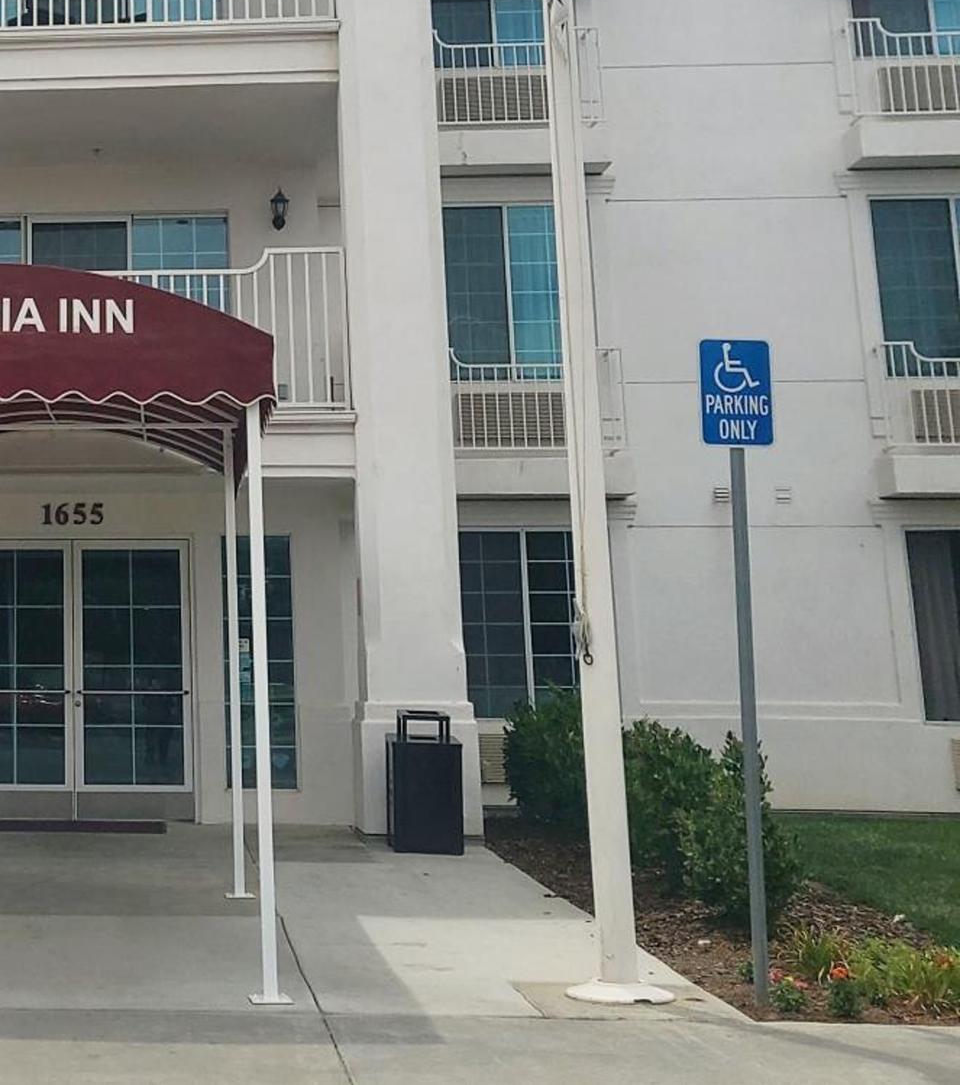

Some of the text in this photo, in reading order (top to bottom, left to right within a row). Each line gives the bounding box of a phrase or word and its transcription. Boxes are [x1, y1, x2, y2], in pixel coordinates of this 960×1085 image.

[58, 298, 135, 334] INN
[705, 394, 769, 416] PARKING
[719, 418, 758, 440] ONLY
[41, 502, 104, 526] 1655
